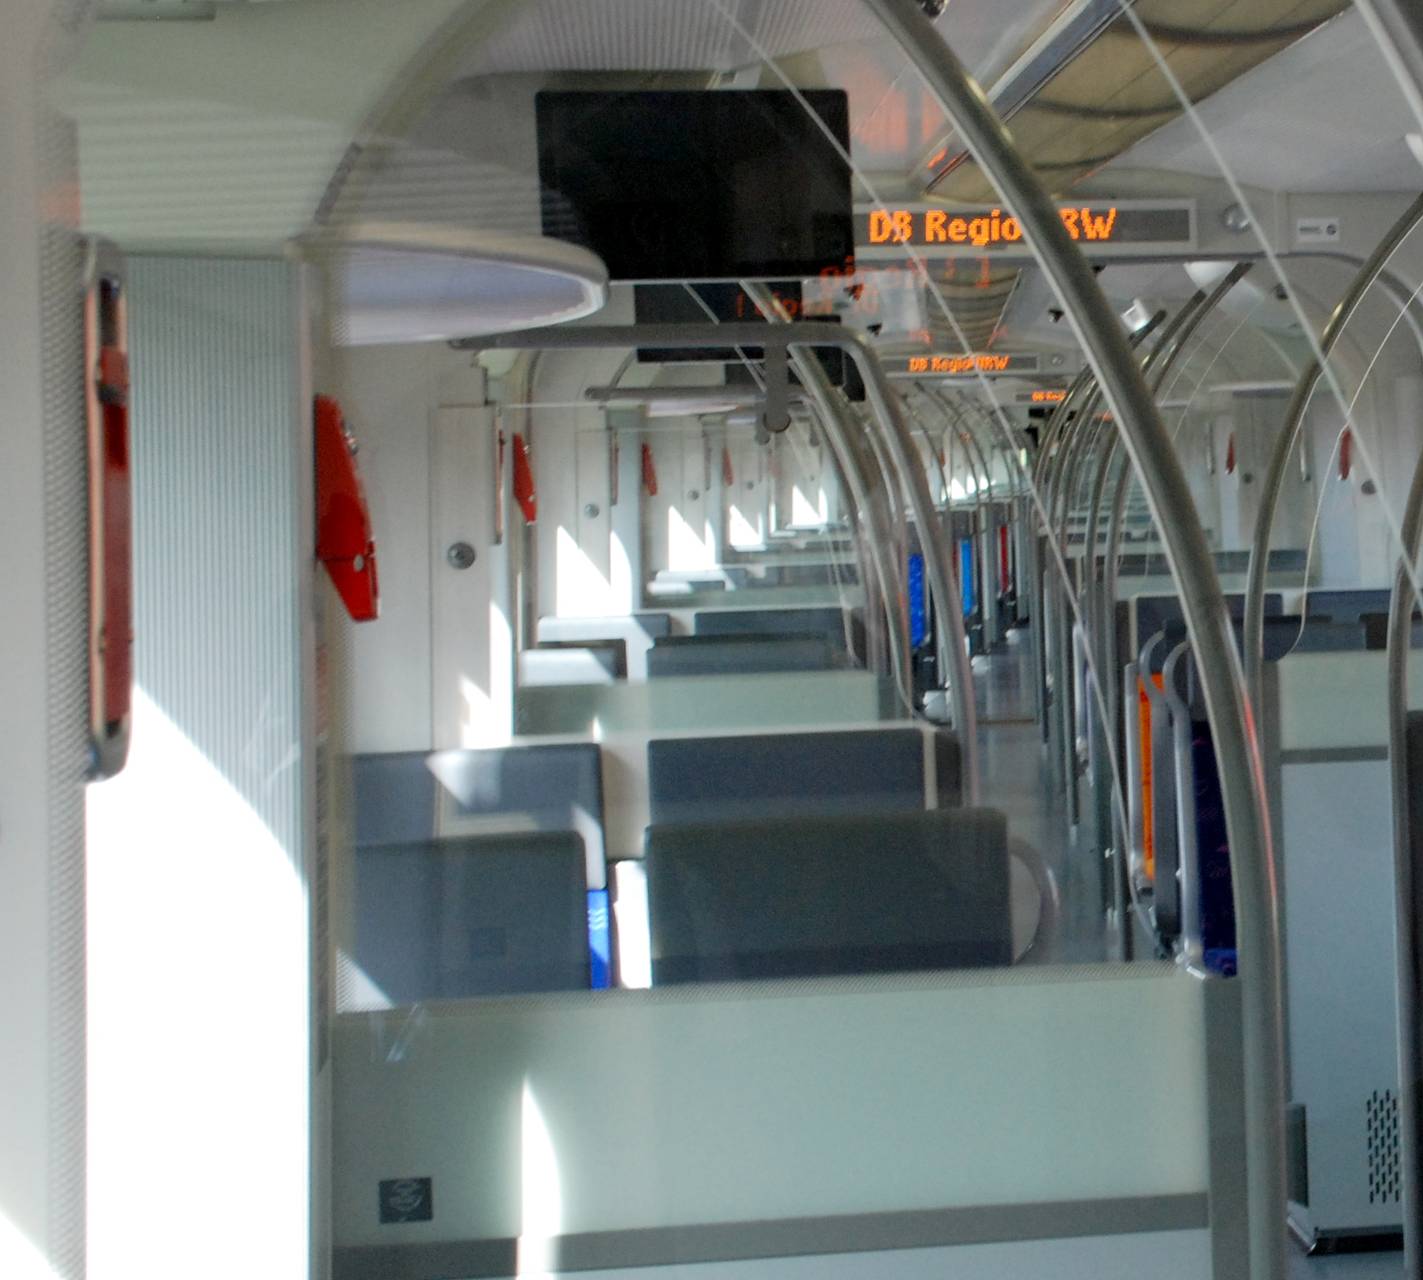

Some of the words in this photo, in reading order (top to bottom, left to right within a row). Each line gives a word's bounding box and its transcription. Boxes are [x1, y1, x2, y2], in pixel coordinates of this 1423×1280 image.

[868, 208, 913, 243] DB
[924, 208, 1023, 246] Regio
[1058, 207, 1117, 240] RW
[909, 357, 929, 372] DB
[931, 356, 975, 373] Regio
